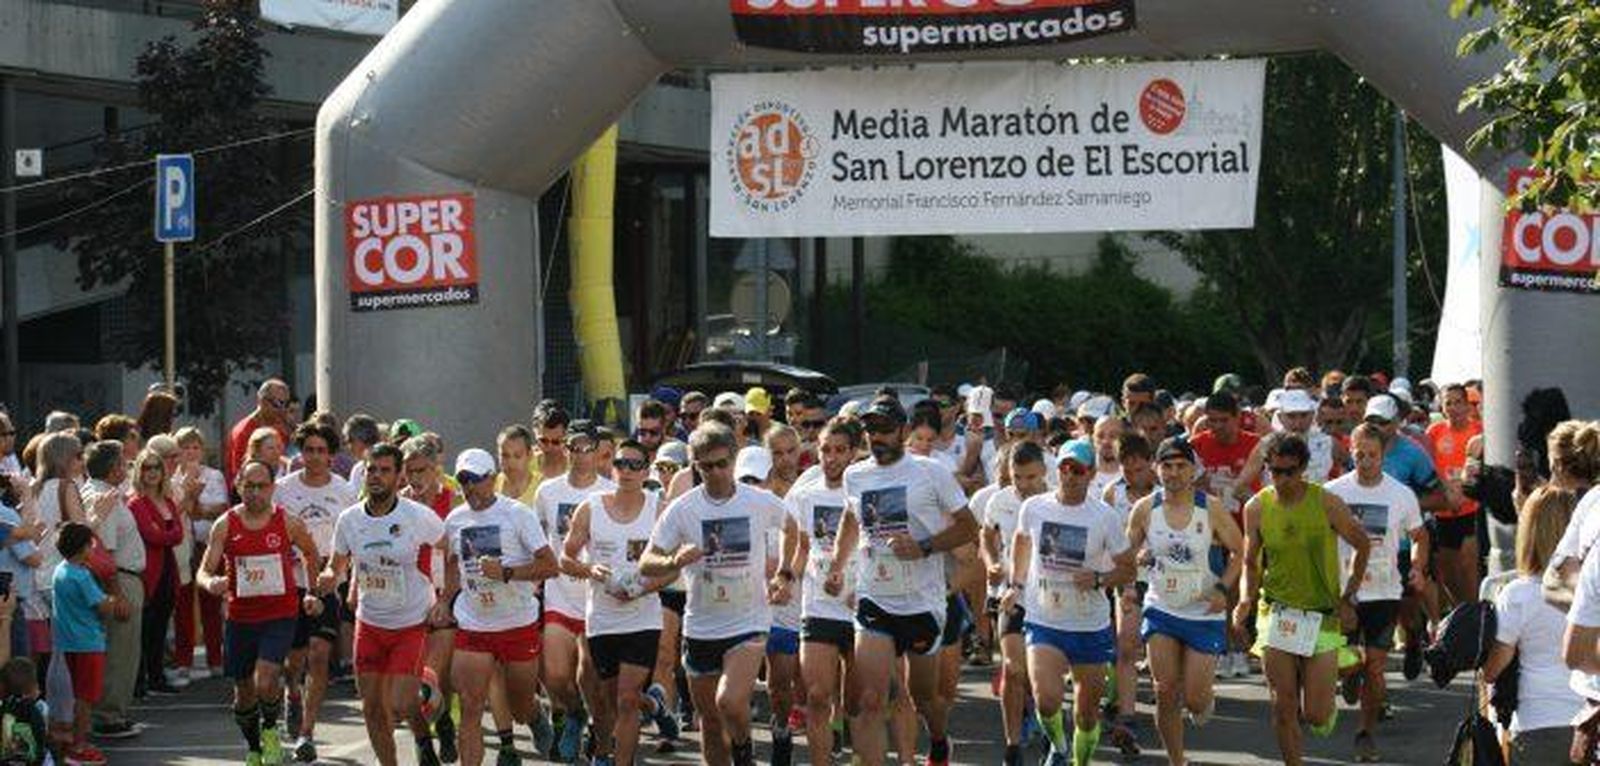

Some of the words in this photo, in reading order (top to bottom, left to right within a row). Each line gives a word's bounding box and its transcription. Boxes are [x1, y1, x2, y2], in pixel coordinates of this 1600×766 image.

[862, 7, 1125, 53] supermercados
[831, 108, 930, 140] Media
[939, 105, 1079, 138] Maratón
[1091, 102, 1130, 134] de
[832, 150, 888, 182] San
[897, 149, 1027, 180] Lorenzo
[1036, 146, 1075, 178] de
[1084, 145, 1113, 176] El
[1121, 142, 1250, 175] Escorial
[165, 166, 187, 231] P
[832, 194, 904, 211] Memorial
[906, 191, 978, 209] Francisco
[982, 189, 1064, 207] Fernández
[1065, 188, 1152, 208] Samaniego
[352, 200, 465, 239] SUPER
[1513, 209, 1600, 266] CO
[353, 232, 469, 286] COR
[357, 286, 471, 309] supermercados
